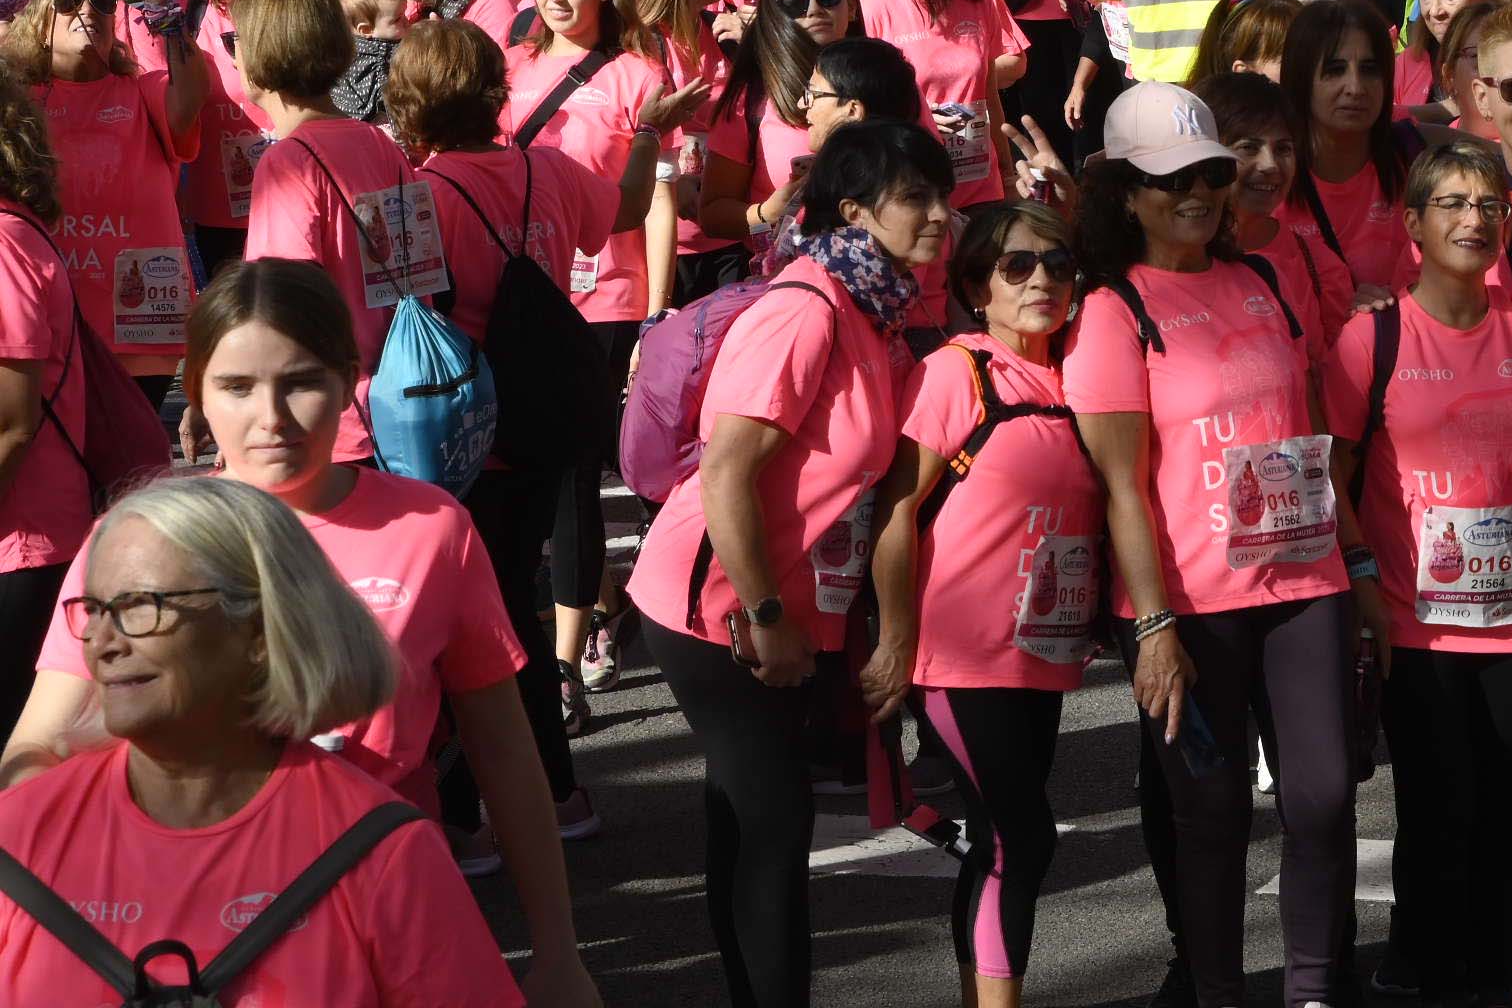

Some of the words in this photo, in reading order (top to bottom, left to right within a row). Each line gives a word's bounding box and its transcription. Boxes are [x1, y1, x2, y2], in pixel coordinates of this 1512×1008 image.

[1171, 104, 1202, 135] NY
[942, 135, 966, 148] 16
[147, 286, 179, 300] 016
[150, 303, 176, 312] 14576
[1398, 367, 1454, 381] OYSHO
[1192, 412, 1236, 447] TU
[1202, 461, 1226, 490] D
[1413, 470, 1454, 499] TU
[1267, 490, 1300, 511] 016
[1026, 505, 1064, 535] TU
[1208, 503, 1228, 533] S
[1468, 555, 1512, 573] 016
[1470, 578, 1505, 590] 21564
[1058, 586, 1086, 605] 016
[1434, 593, 1472, 601] CARRERA
[1473, 594, 1484, 602] DE
[1428, 606, 1471, 618] OYSHO
